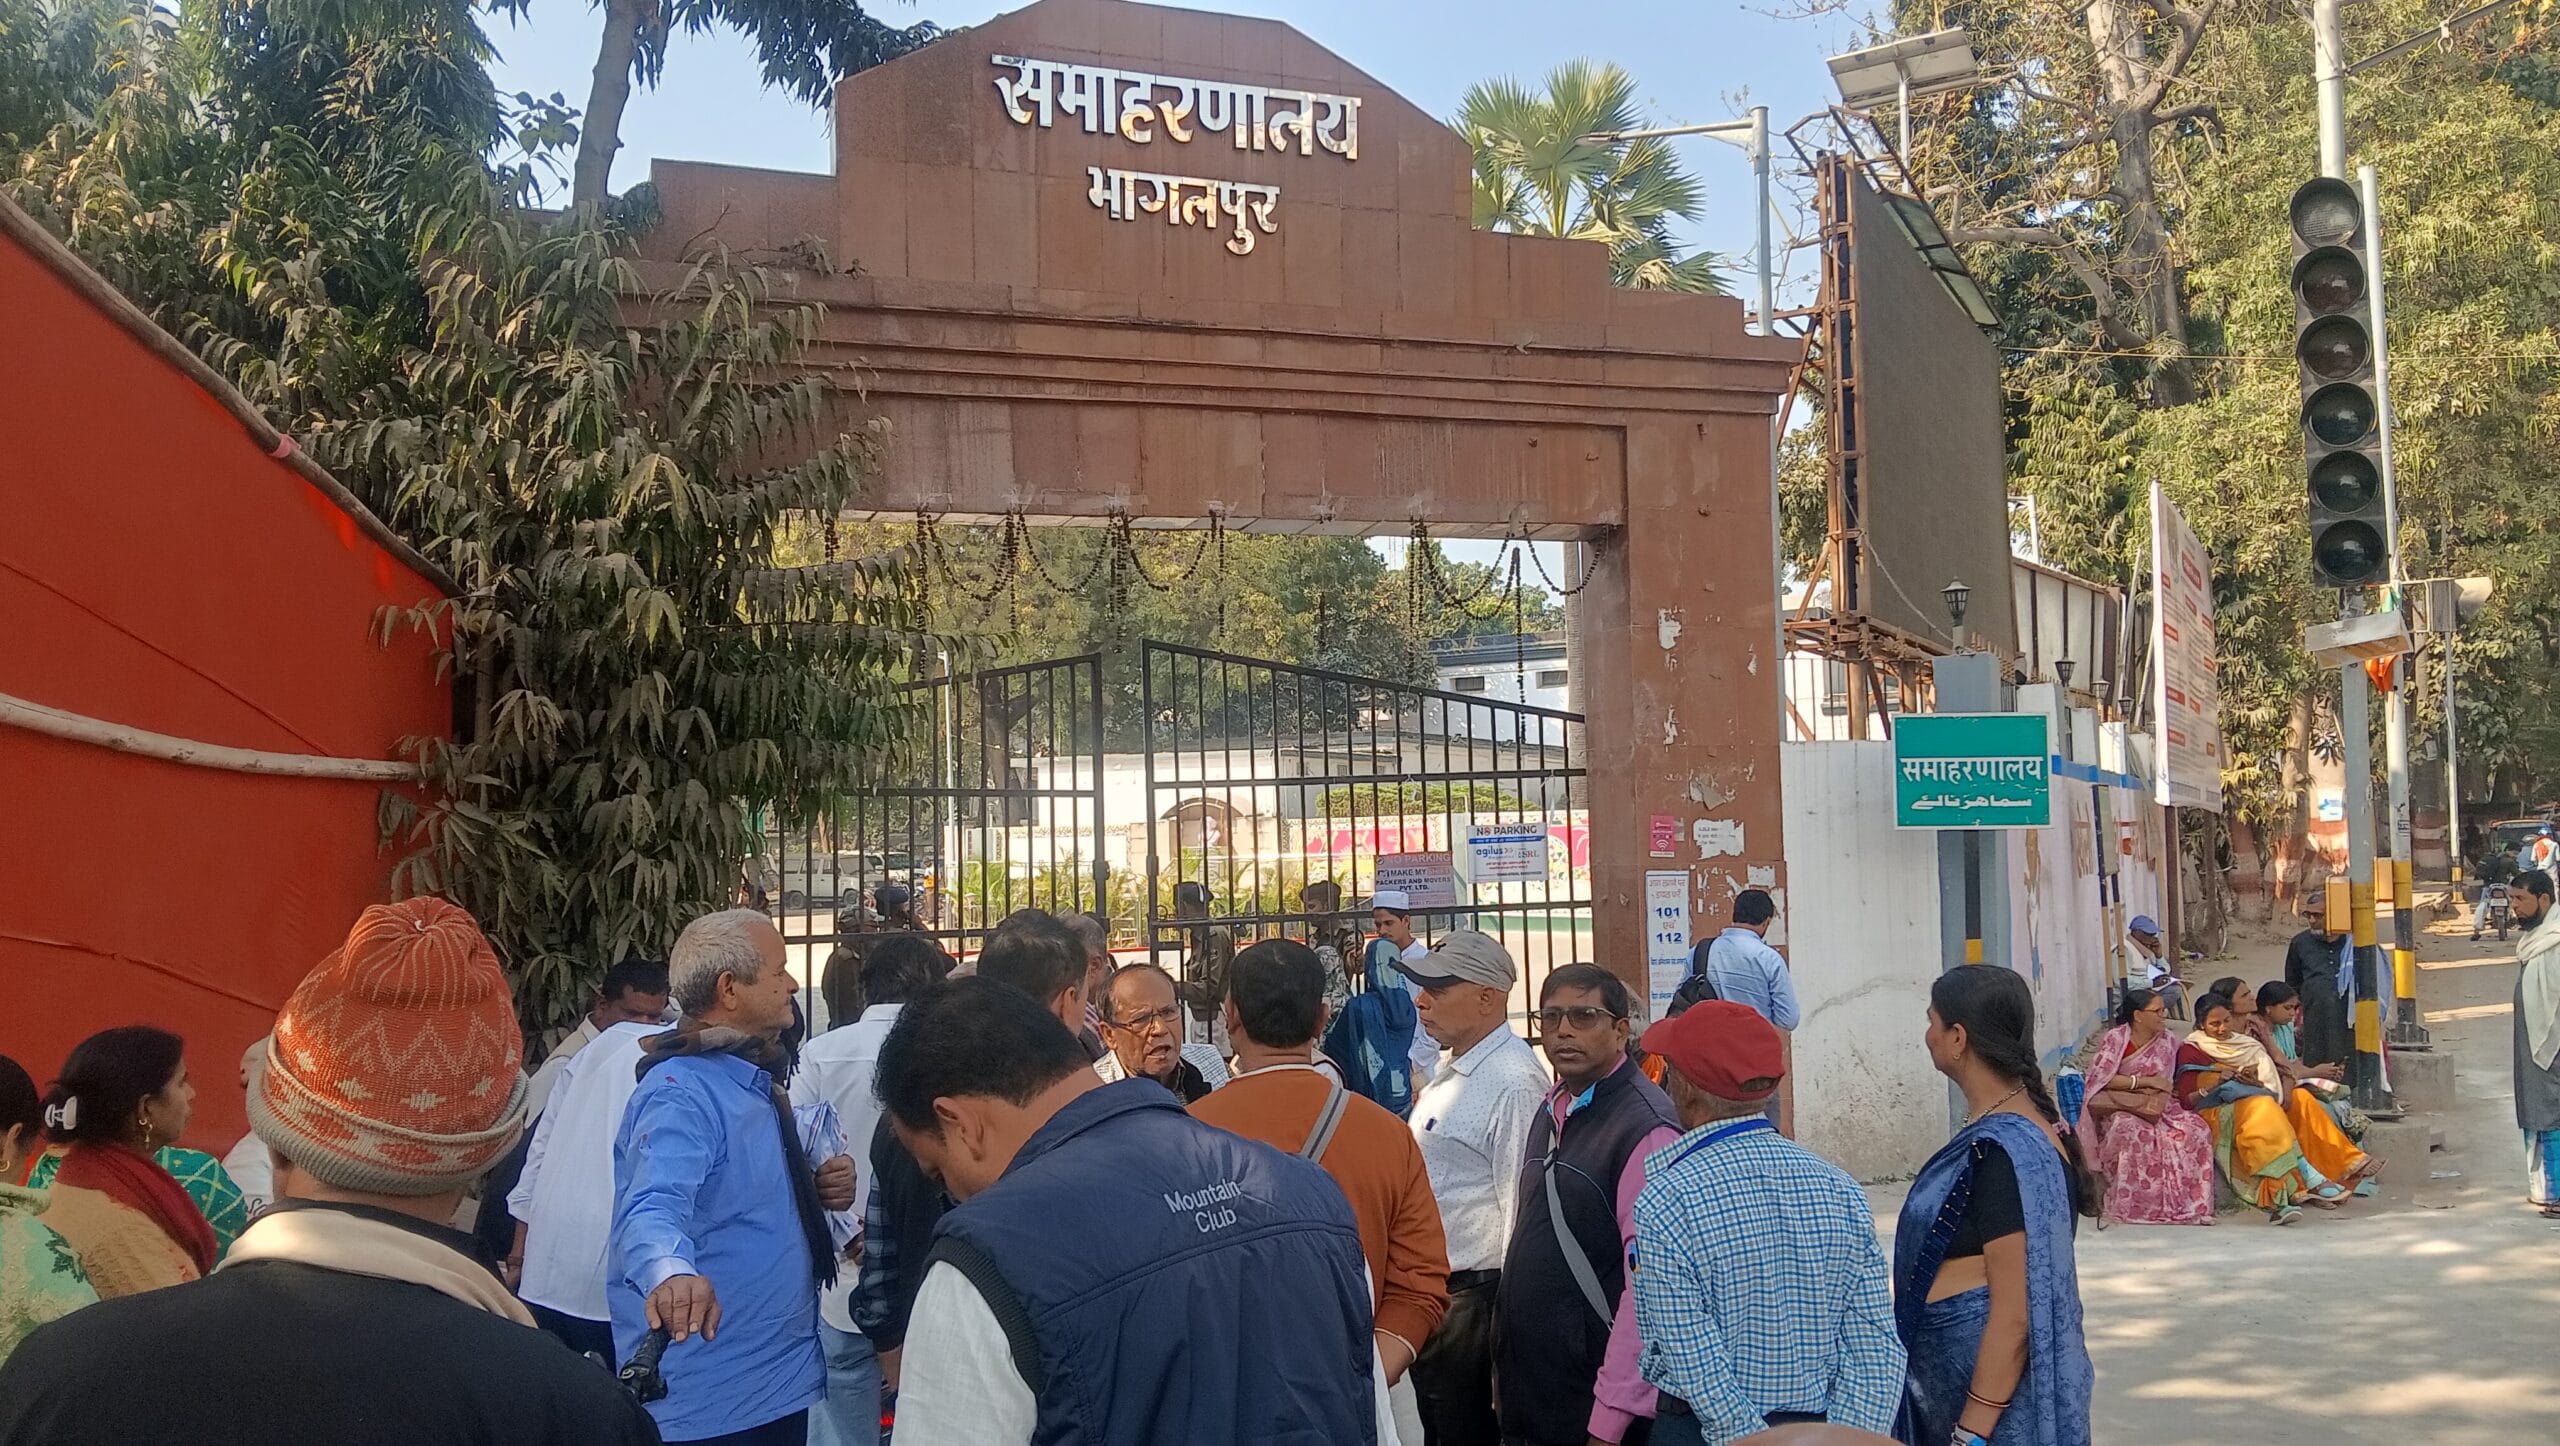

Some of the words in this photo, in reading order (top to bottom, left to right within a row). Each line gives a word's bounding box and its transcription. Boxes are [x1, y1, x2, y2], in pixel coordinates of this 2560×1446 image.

[991, 53, 1362, 161] समाहरणालय
[1087, 165, 1281, 256] भागलपुर
[1900, 756, 2045, 785] समाहरणालय
[1494, 825, 1537, 835] PARKING
[1405, 853, 1451, 863] PARKING
[1476, 845, 1503, 858] agilus
[1655, 907, 1680, 917] 101
[1656, 932, 1682, 942] 112
[1164, 1178, 1242, 1213] Mountain
[1195, 1206, 1237, 1233] Club
